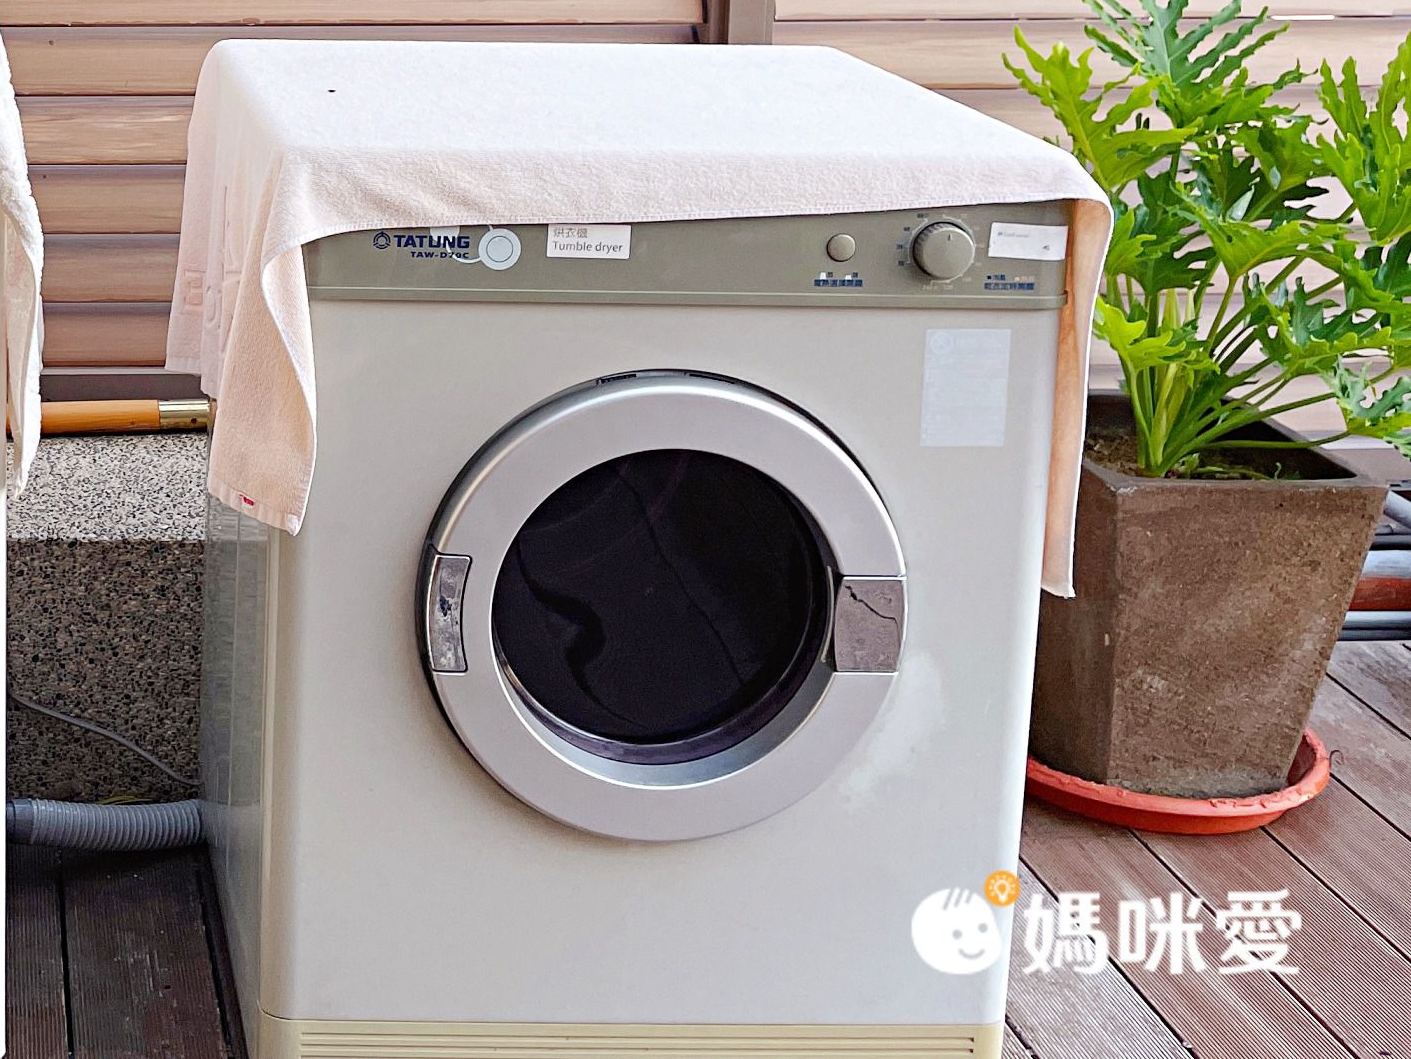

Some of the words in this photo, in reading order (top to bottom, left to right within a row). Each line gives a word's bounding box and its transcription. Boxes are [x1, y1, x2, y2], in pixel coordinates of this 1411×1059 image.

[393, 234, 470, 249] TATUNG
[553, 241, 593, 252] Tumble
[595, 241, 623, 254] dryer
